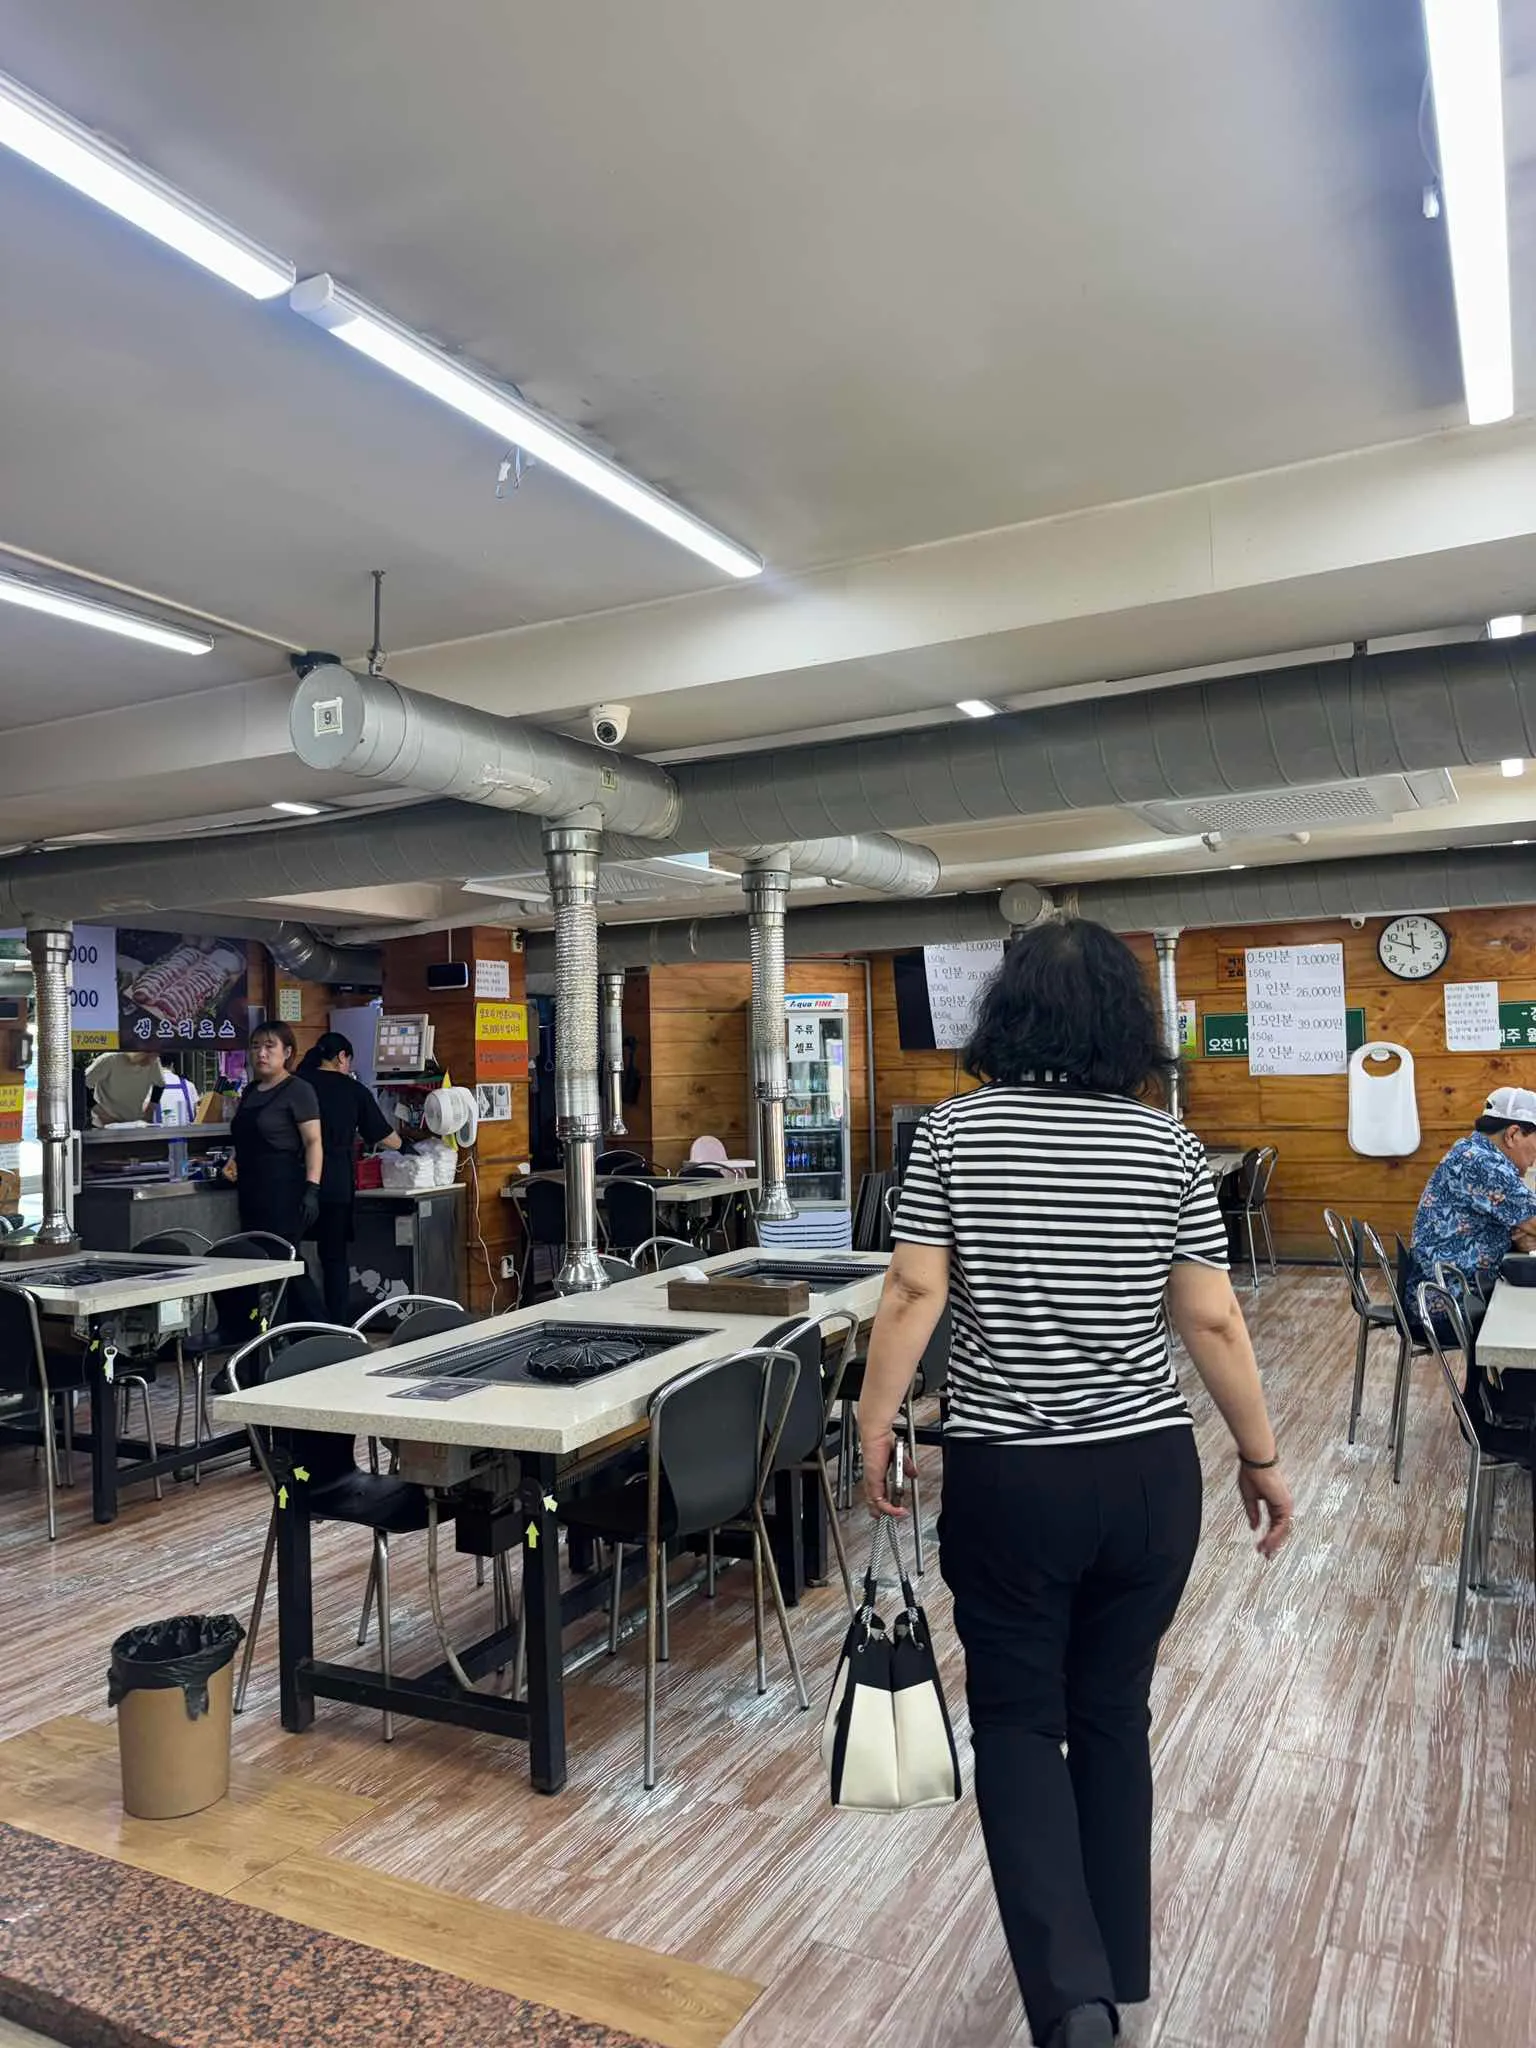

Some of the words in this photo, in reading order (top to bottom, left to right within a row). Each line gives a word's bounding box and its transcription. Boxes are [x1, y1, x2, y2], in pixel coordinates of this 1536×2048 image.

[324, 711, 331, 725] 9
[1396, 923, 1404, 932] 11
[1407, 919, 1418, 928] 12
[1387, 933, 1398, 941] 10
[1430, 930, 1439, 939] 2
[1383, 944, 1392, 952] 9
[1433, 941, 1443, 949] 3
[1246, 950, 1292, 964] 0.5인분
[1388, 955, 1397, 963] 8
[1431, 952, 1439, 960] 4
[1397, 963, 1405, 971] 7
[1410, 965, 1419, 974] 6
[1423, 962, 1432, 970] 5
[1266, 981, 1292, 996] 인분
[794, 1024, 814, 1035] 주류
[1208, 1038, 1233, 1052] 오전
[1256, 1046, 1264, 1058] 2
[1269, 1044, 1295, 1060] 인분
